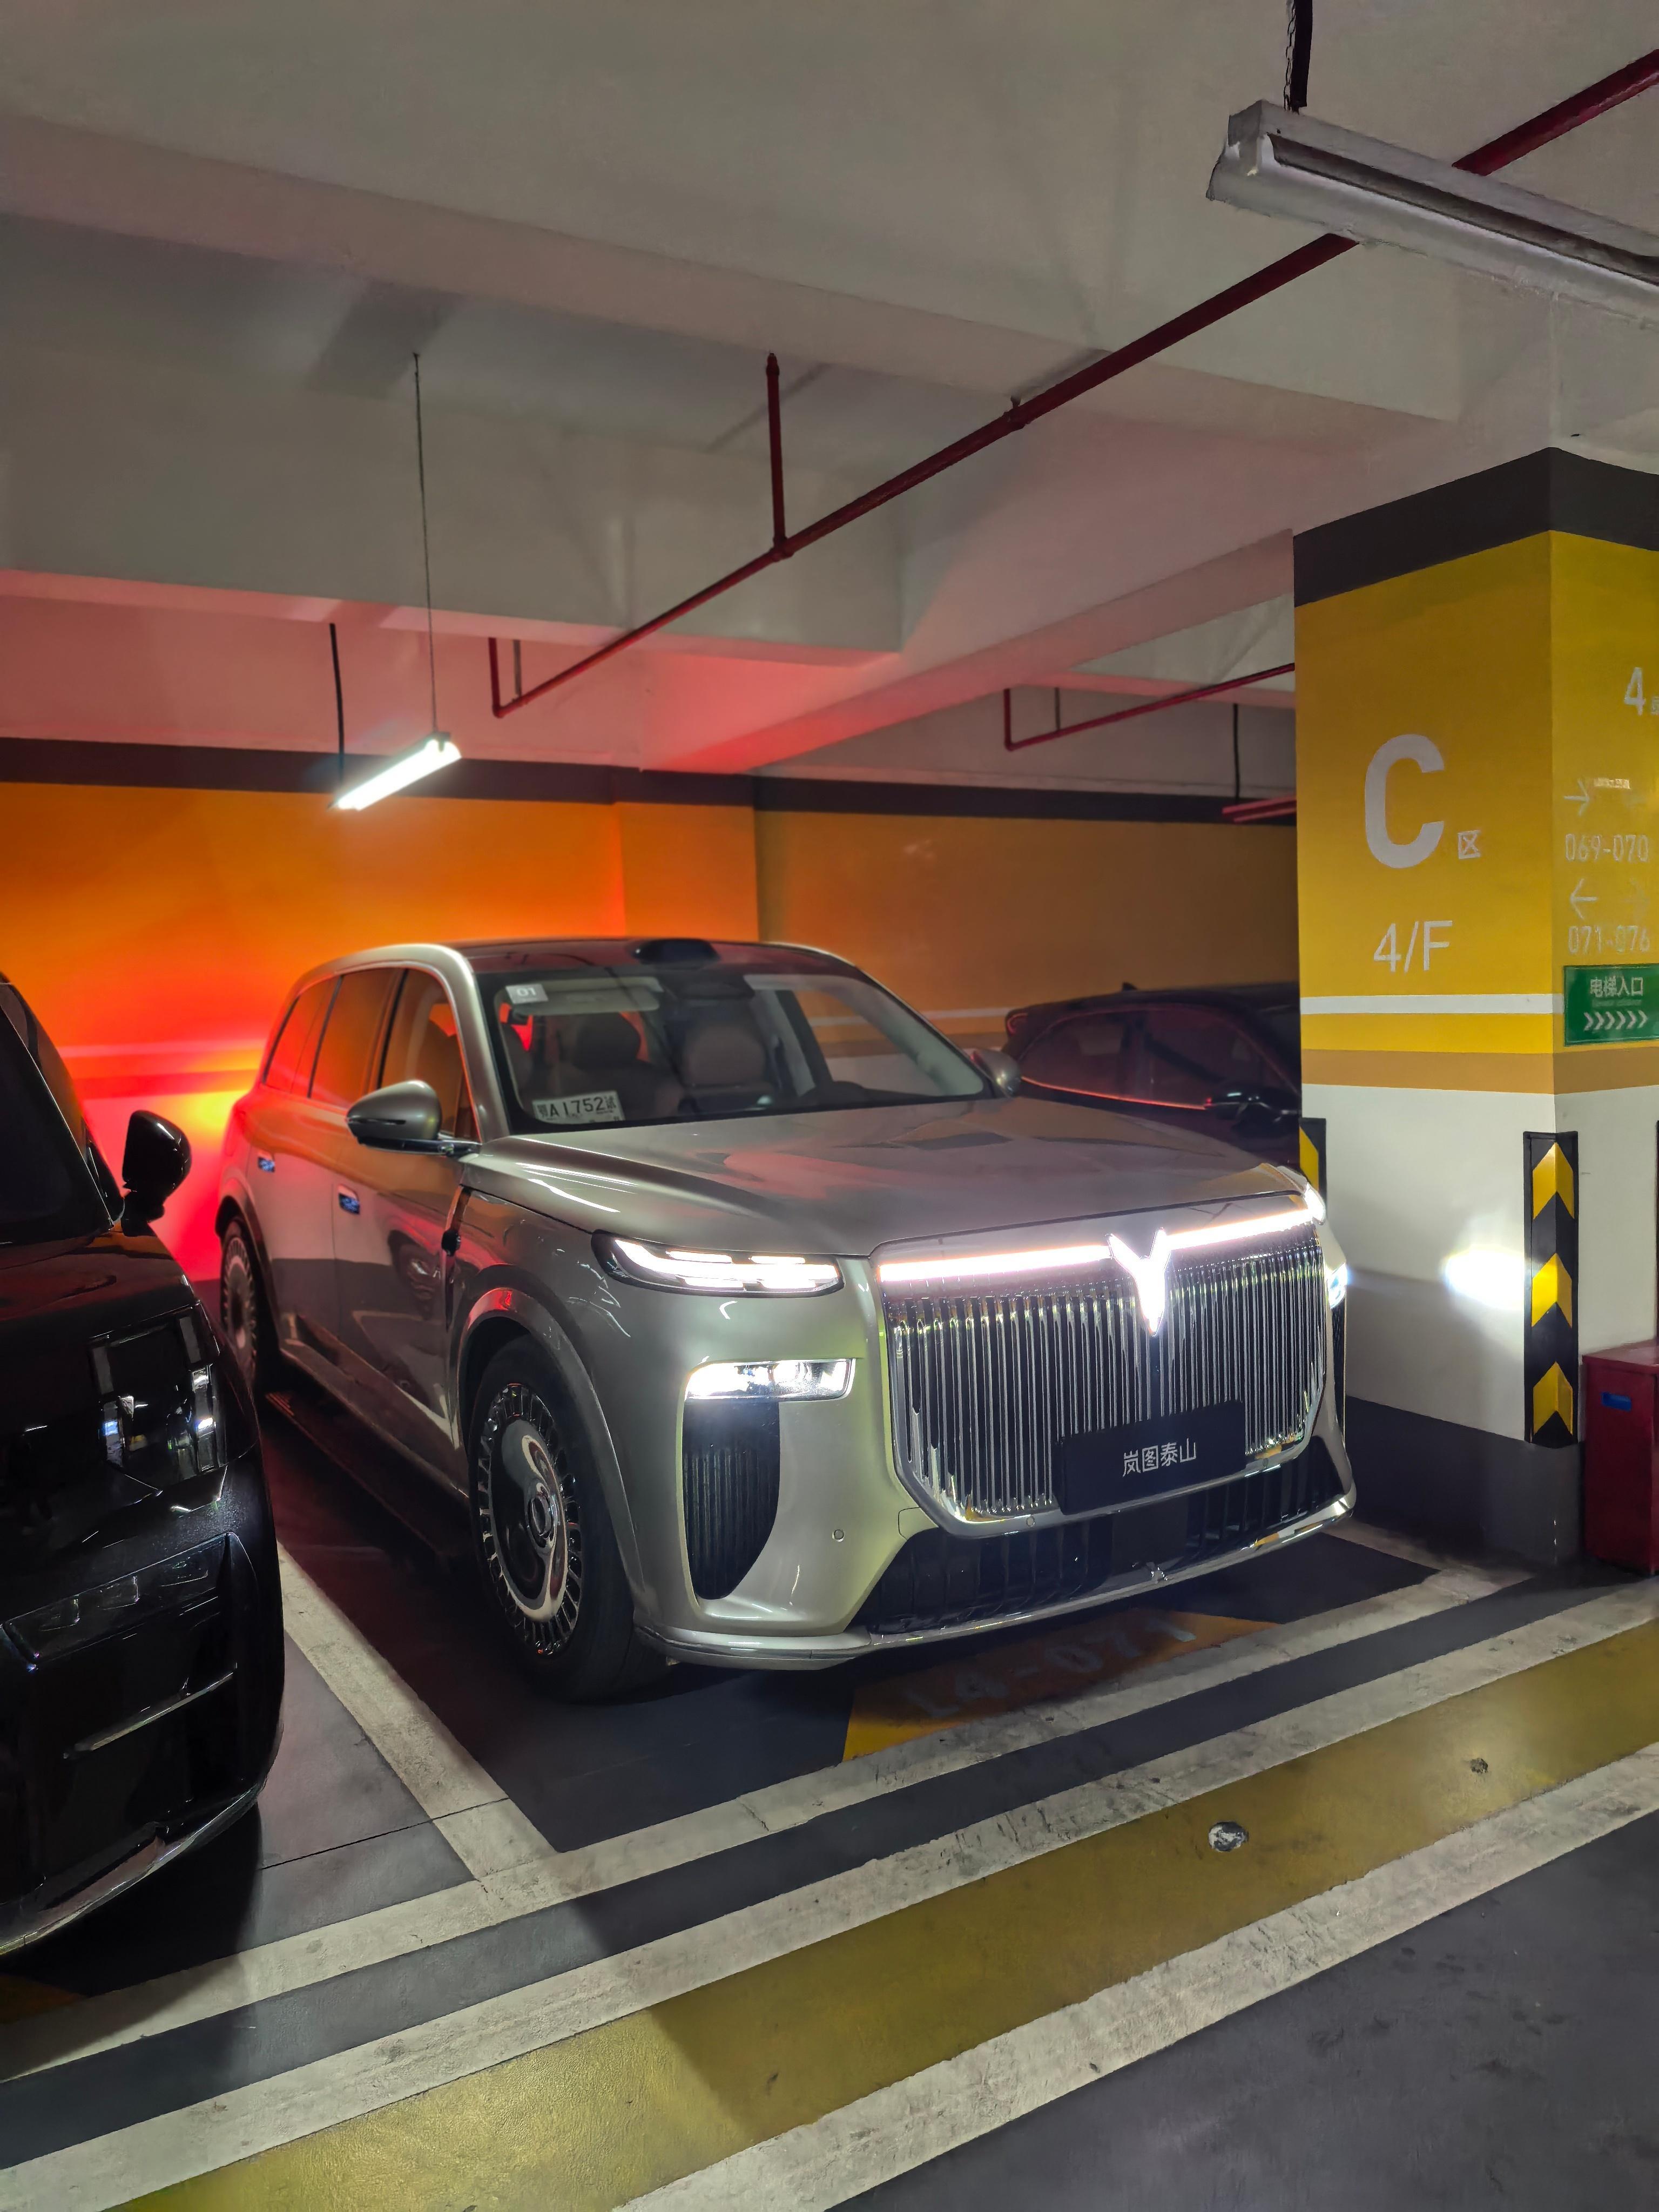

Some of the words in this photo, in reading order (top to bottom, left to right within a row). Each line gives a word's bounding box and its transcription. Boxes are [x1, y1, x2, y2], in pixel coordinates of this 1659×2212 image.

[1565, 833, 1650, 862] 069-070
[1373, 920, 1453, 973] 4/F
[1568, 925, 1650, 954] 071-076
[1590, 975, 1643, 998] 电梯入口
[1122, 1438, 1197, 1477] 岚图泰山
